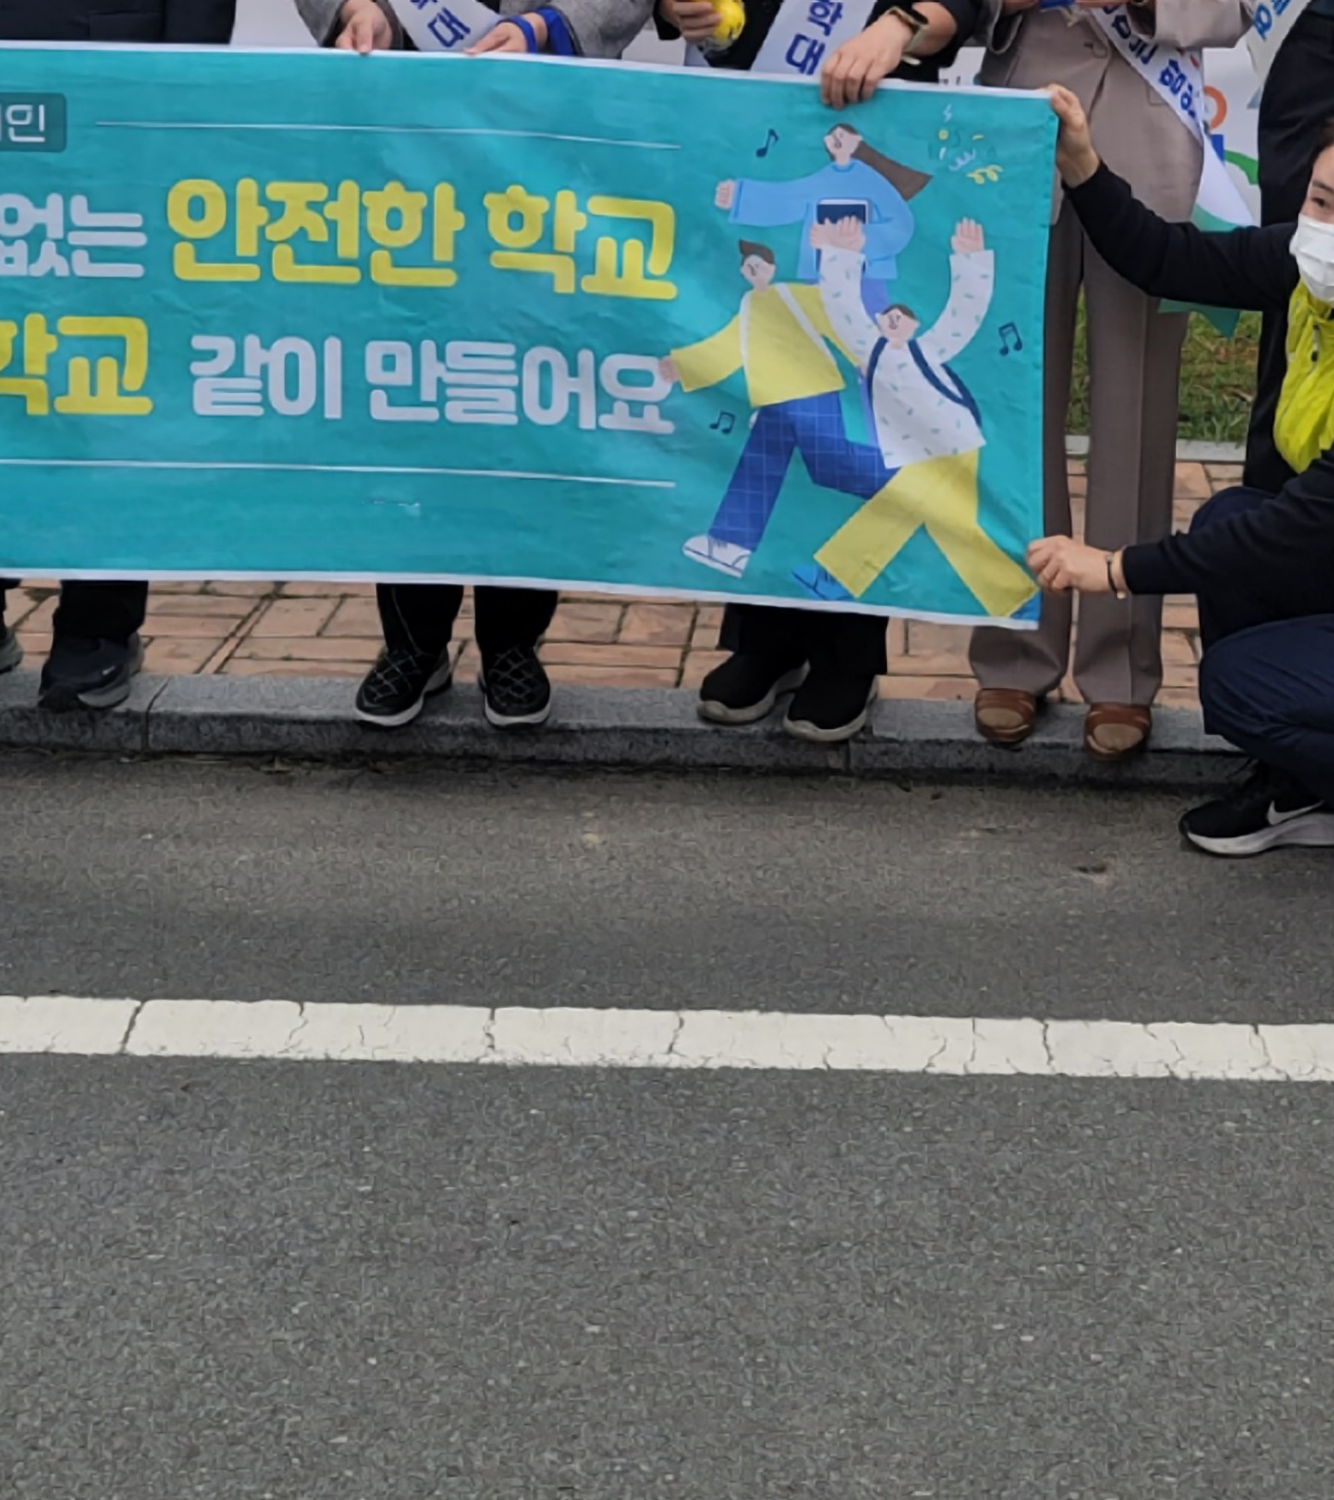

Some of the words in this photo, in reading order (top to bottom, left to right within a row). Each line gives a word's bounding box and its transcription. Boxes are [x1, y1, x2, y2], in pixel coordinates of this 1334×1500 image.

[166, 177, 464, 287] 안전한
[483, 185, 678, 300] 학교
[190, 333, 342, 419] 같이
[365, 338, 676, 434] 만들어요
